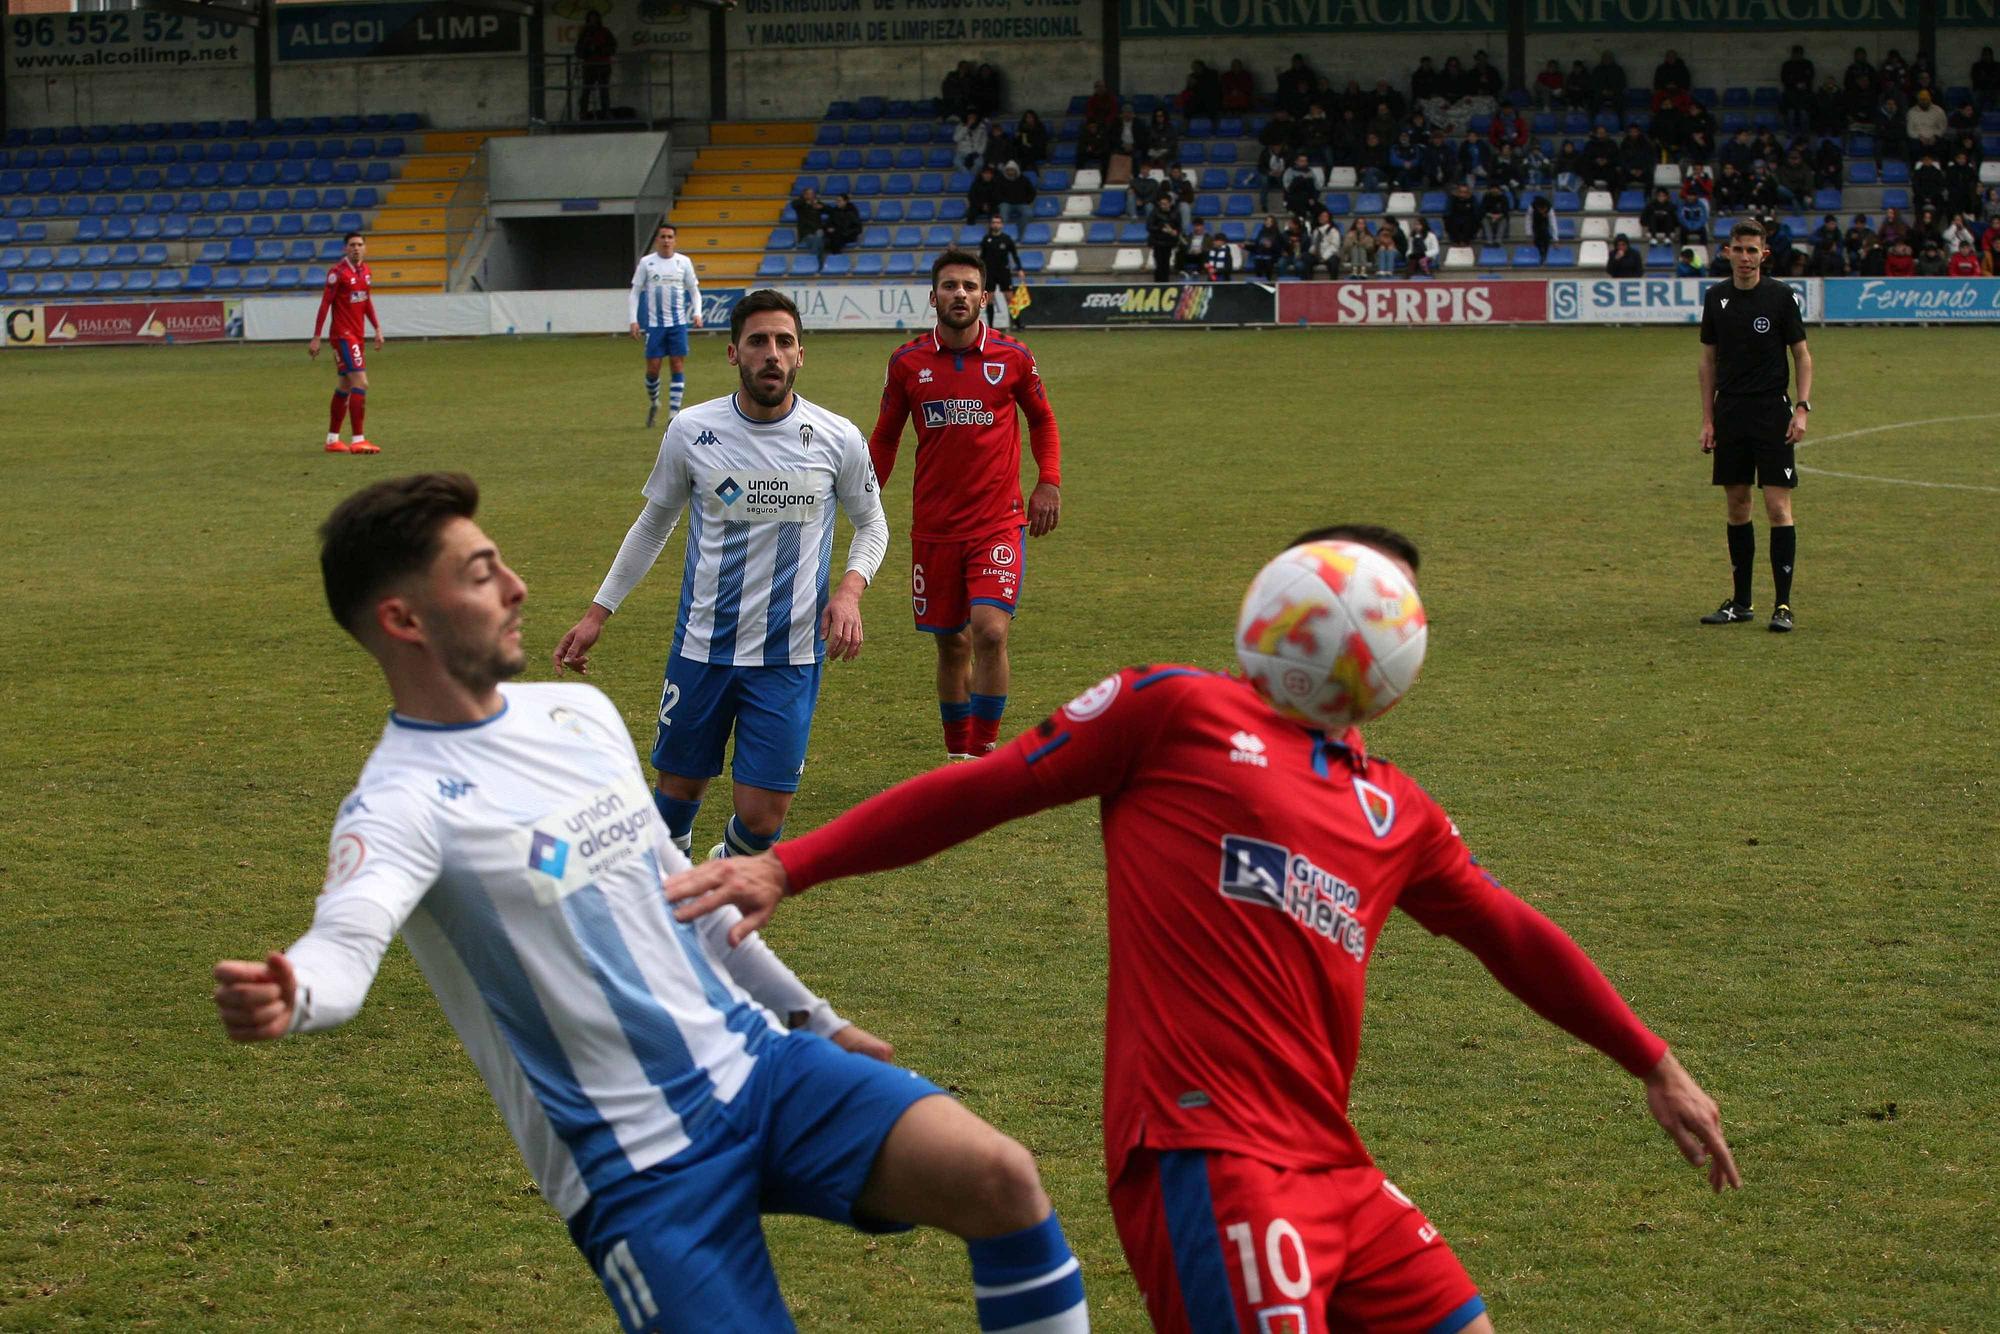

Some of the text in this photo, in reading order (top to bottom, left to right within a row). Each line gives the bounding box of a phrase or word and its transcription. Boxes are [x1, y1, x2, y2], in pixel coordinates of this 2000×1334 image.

[14, 17, 54, 47] 96
[67, 14, 129, 45] 552
[143, 13, 184, 42] 52
[290, 15, 499, 46] ALCOI LIMP
[746, 16, 1083, 45] Y MAQUINARIA DE LIMPIEZA PROFESIONAL
[15, 45, 239, 69] www.alcoilimp.net
[878, 289, 915, 315] UA
[1337, 284, 1493, 323] SERPIS
[1857, 280, 1978, 310] Fernando
[6, 309, 34, 342] C
[78, 318, 132, 331] HALCON
[166, 315, 221, 329] HALCON
[352, 344, 361, 357] 3
[946, 399, 982, 411] Grupo
[947, 411, 993, 425] Herce
[748, 477, 789, 491] unión
[746, 493, 815, 509] alcoyana
[913, 563, 925, 594] 6
[983, 568, 1017, 579] E.Leclerc
[1292, 857, 1358, 909] Grupo
[1226, 1218, 1311, 1304] 10
